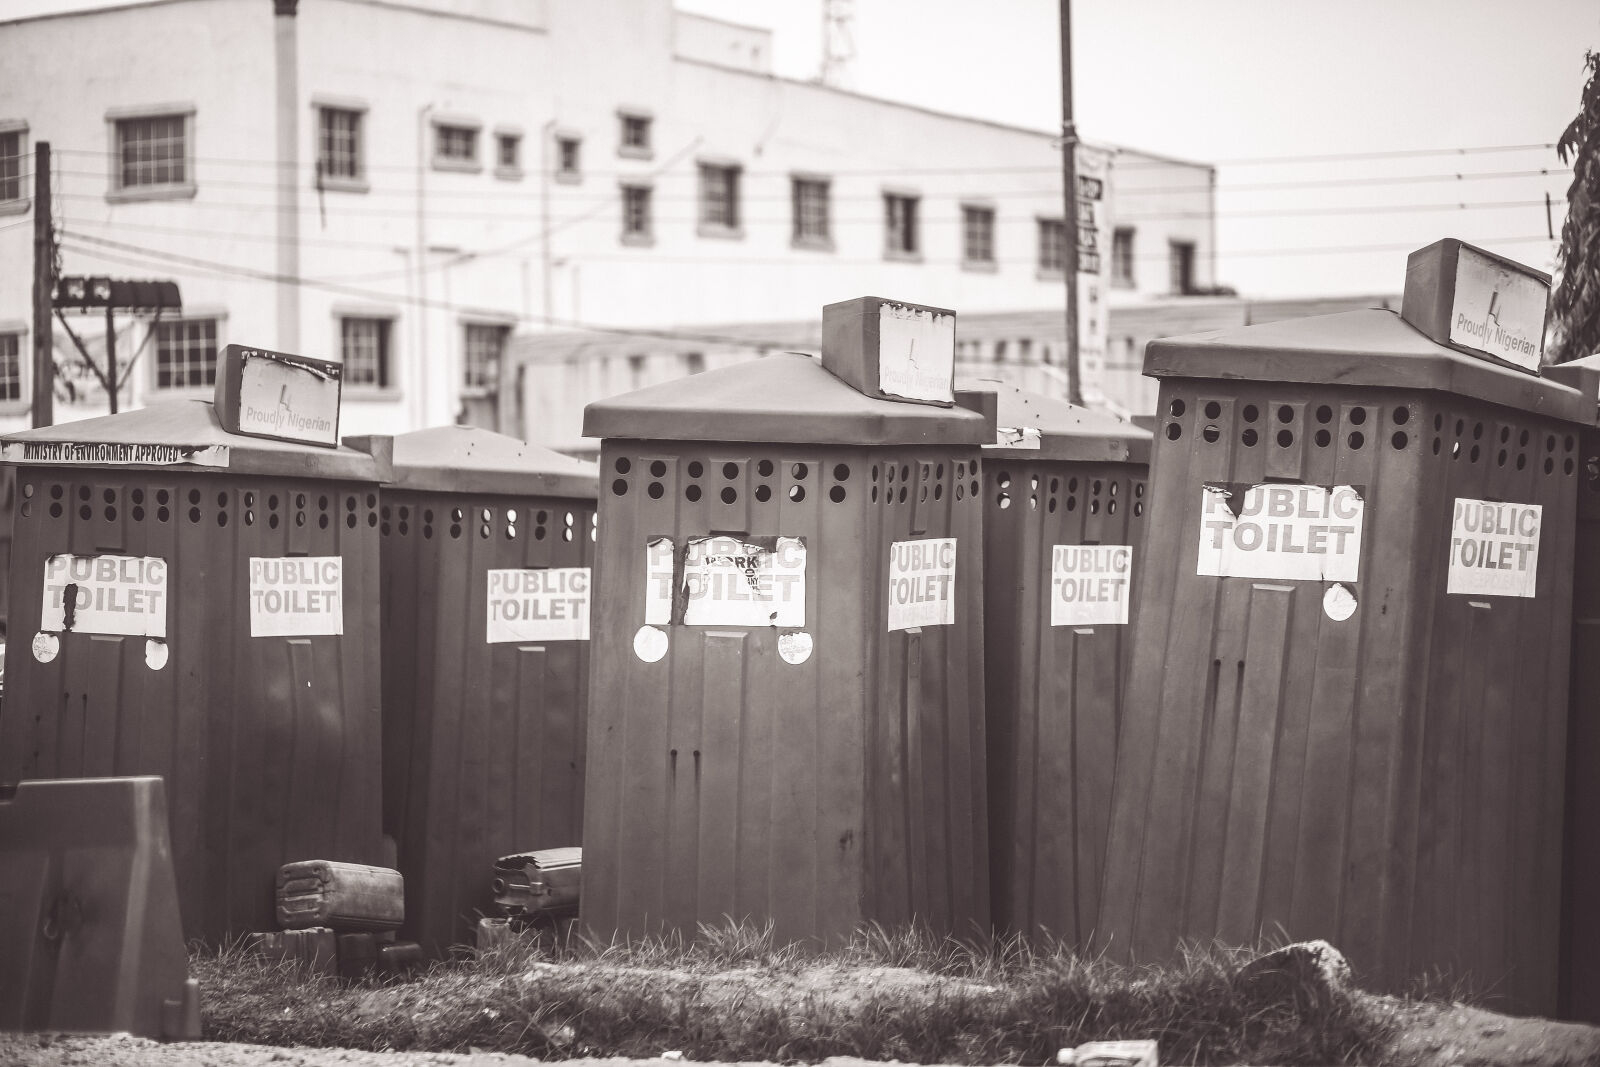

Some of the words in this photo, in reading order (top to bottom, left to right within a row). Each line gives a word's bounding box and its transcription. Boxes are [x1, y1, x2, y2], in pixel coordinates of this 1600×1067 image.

[1457, 313, 1493, 344] Proudly
[1495, 328, 1536, 356] Nigerian
[247, 407, 285, 426] Proudly
[287, 413, 331, 432] Nigerian
[23, 443, 62, 460] MINISTRY
[64, 443, 75, 460] OF
[76, 444, 133, 461] ENVIRONMENT
[135, 445, 178, 462] APPROVED
[1205, 488, 1359, 519] PUBLIC
[1454, 503, 1539, 537] PUBLIC
[1205, 521, 1355, 555] TOILET
[650, 541, 804, 569] PUBIC
[891, 543, 955, 572] PUBLIC
[1054, 549, 1130, 573] PUBLIC
[1451, 538, 1535, 571] TOILET
[47, 557, 164, 585] PUBLIC
[252, 561, 339, 585] PUBLIC
[490, 572, 588, 594] PUBLIC
[47, 585, 162, 614] TOILET
[252, 590, 337, 614] TOILET
[890, 575, 953, 605] TOILET
[490, 599, 586, 621] TOILET
